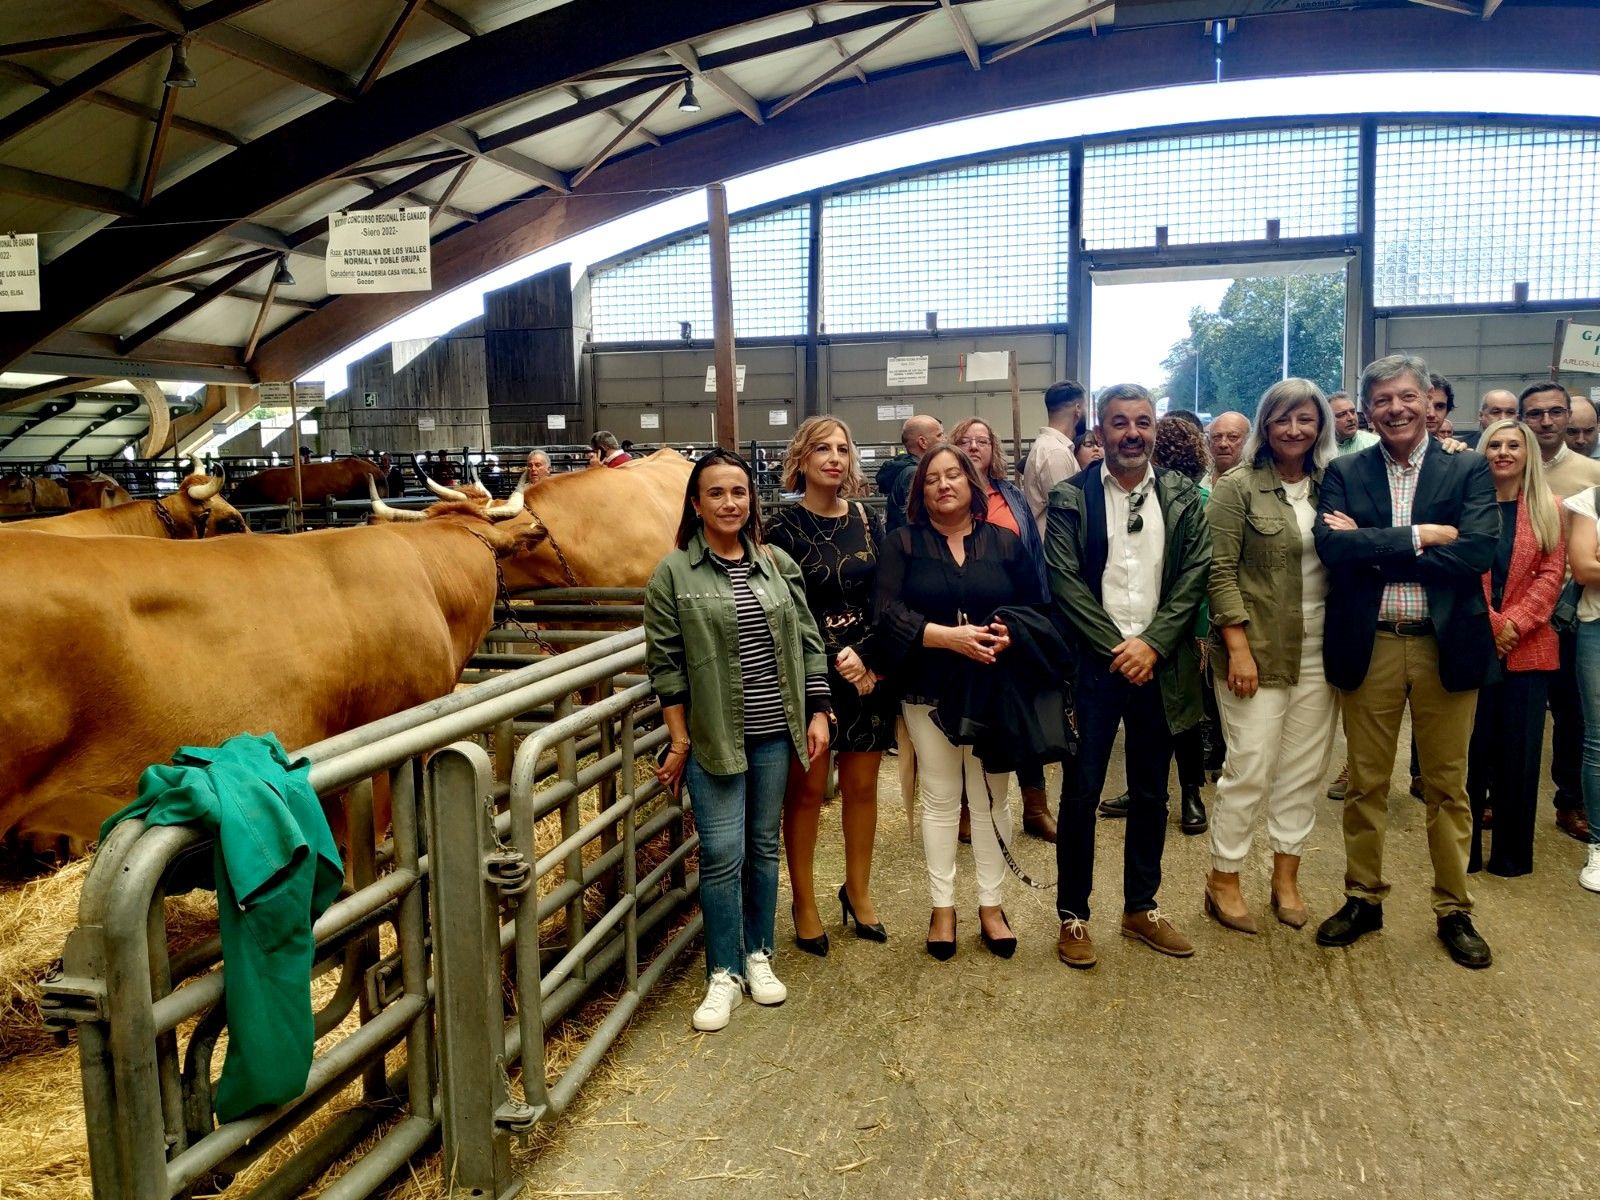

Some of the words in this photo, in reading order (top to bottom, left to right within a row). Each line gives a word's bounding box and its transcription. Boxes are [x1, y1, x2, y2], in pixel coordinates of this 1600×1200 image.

[347, 214, 375, 224] CONCURSO
[375, 213, 399, 223] REGIONAL
[400, 212, 406, 222] DE
[407, 211, 427, 221] GANADO
[382, 227, 399, 236] 2022-
[343, 248, 381, 257] ASTURIANA
[383, 248, 391, 256] DE
[392, 247, 404, 255] LOS
[405, 245, 427, 254] VALLES
[344, 257, 373, 265] NORMAL
[374, 257, 379, 265] Y
[380, 256, 399, 264] DOBLE
[400, 254, 420, 263] GRUPA
[17, 269, 36, 277] VALLES
